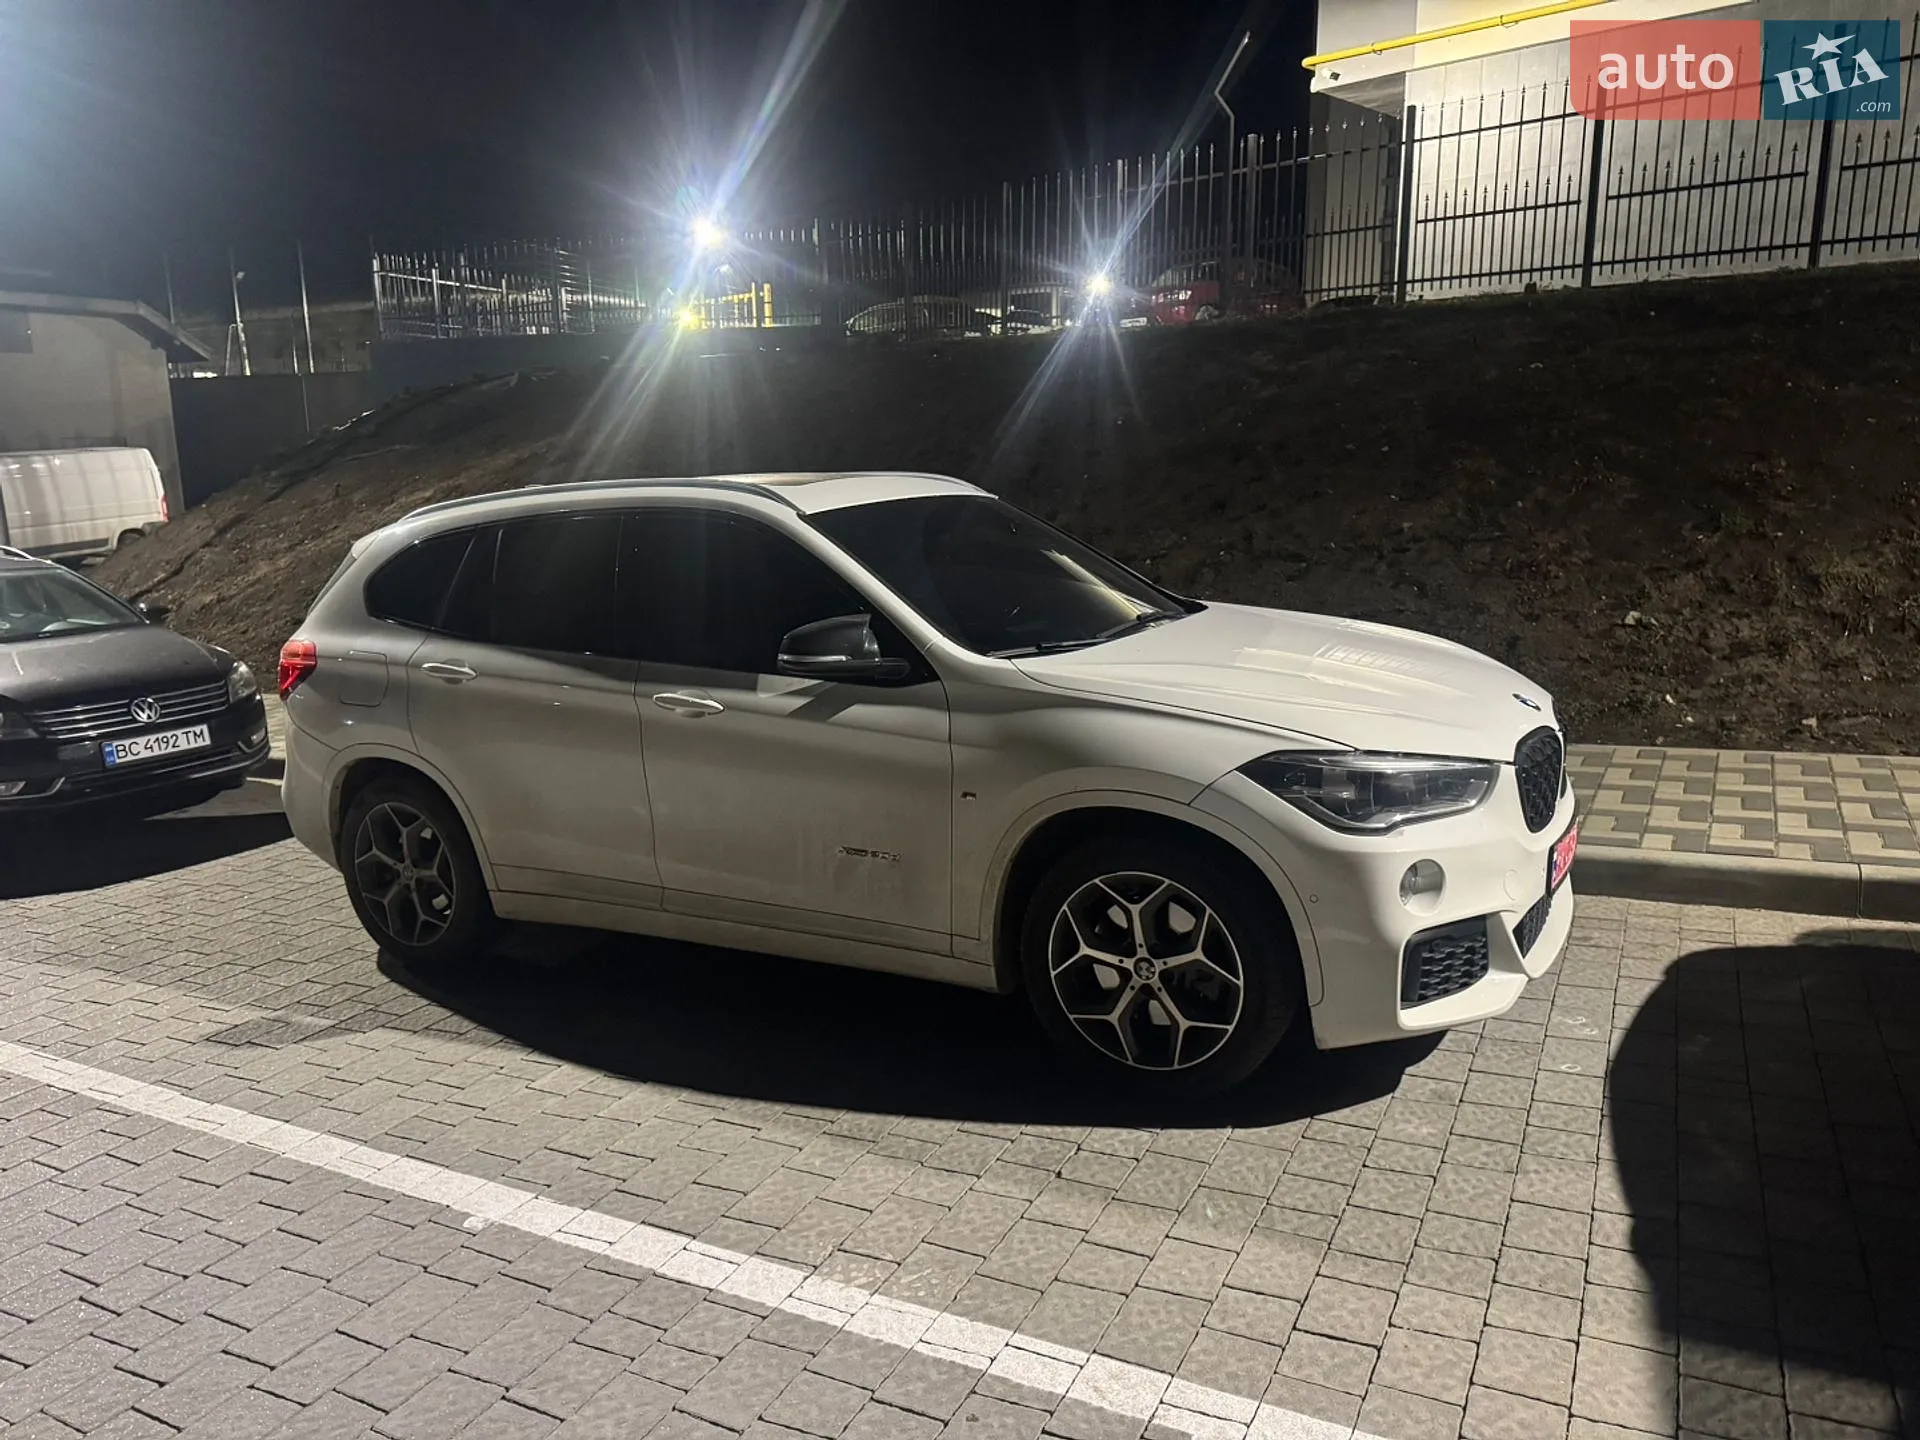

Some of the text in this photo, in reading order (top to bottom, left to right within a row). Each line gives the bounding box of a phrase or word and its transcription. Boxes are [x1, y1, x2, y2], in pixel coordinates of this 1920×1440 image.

[114, 729, 206, 760] BC 4192 TM
